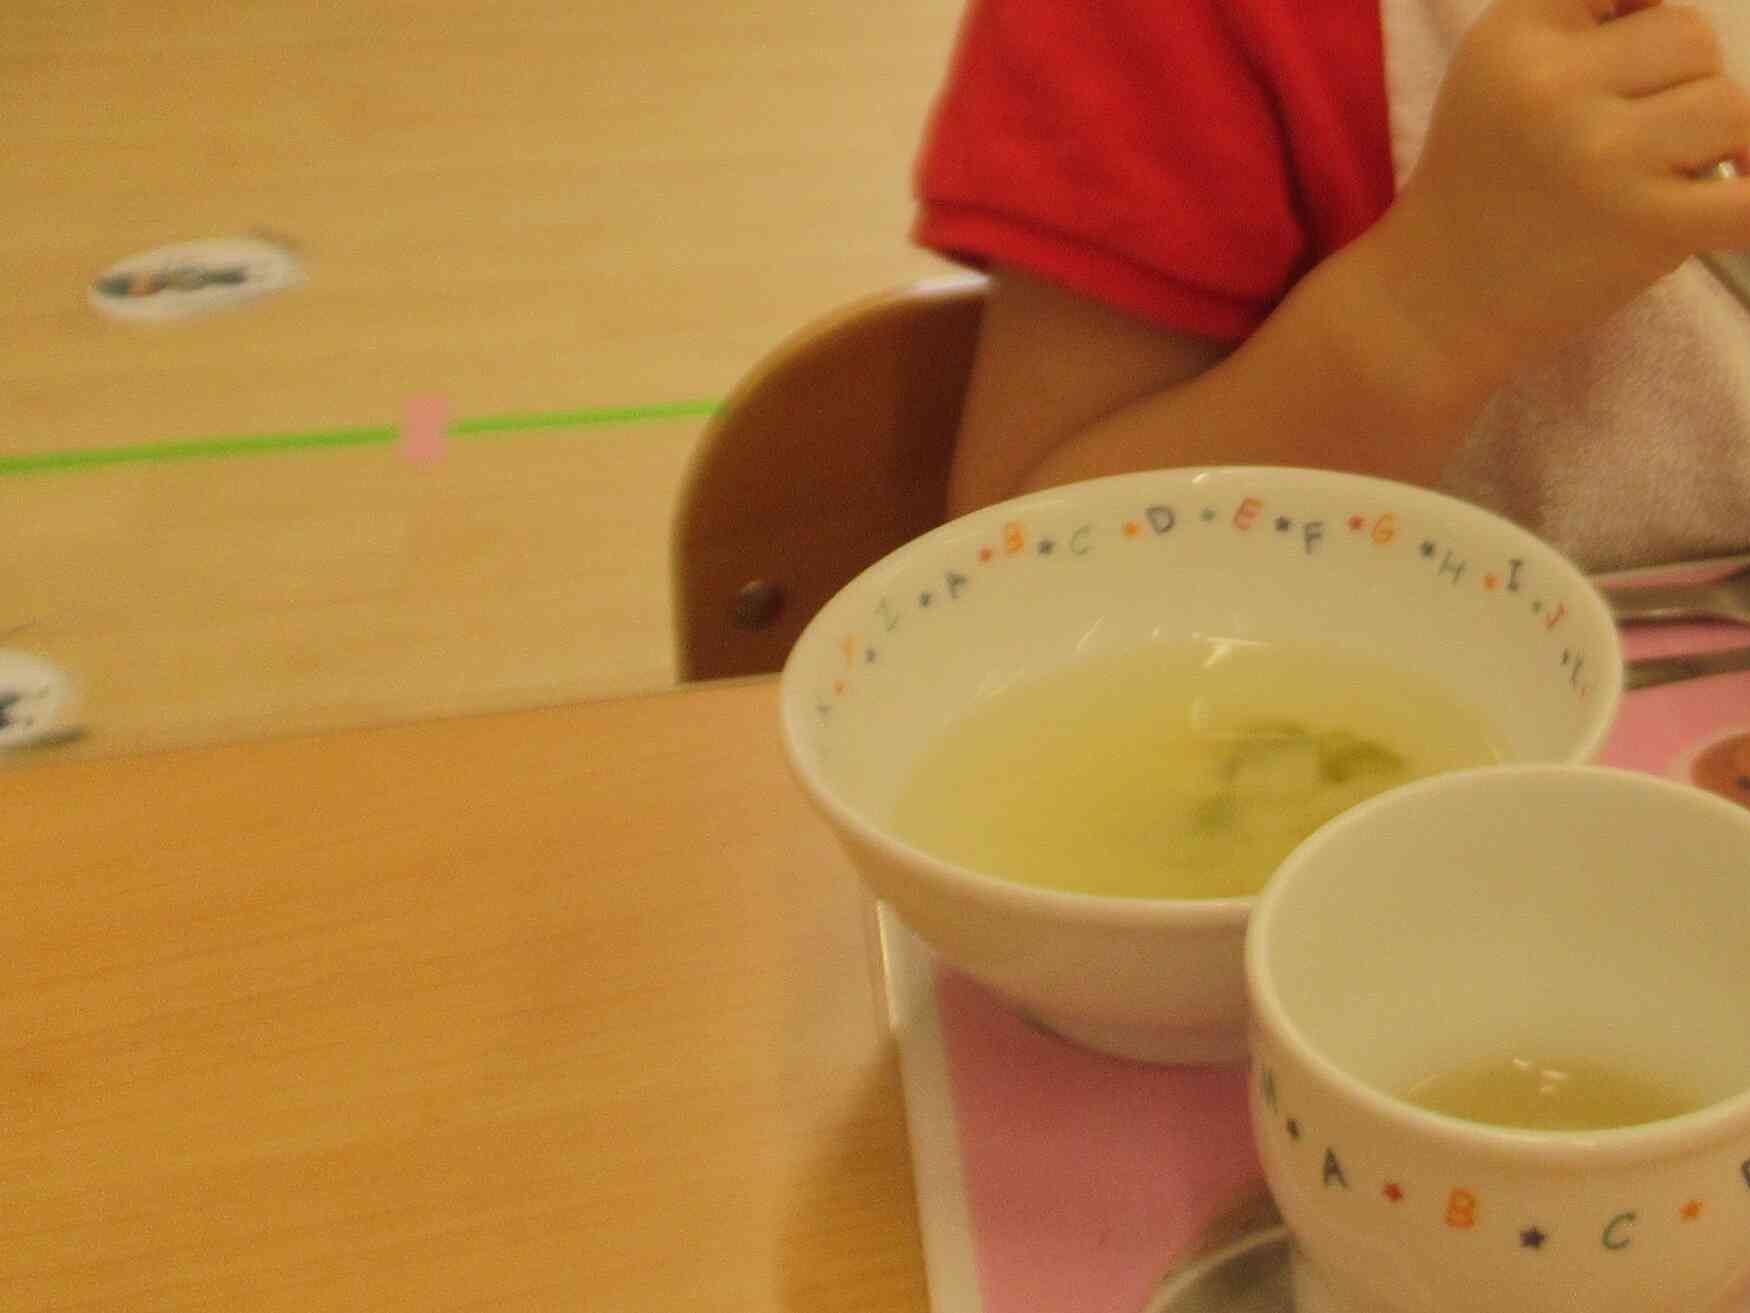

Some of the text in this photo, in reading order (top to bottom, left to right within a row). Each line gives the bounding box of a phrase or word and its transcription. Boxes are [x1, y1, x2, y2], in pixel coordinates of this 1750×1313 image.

[1003, 520, 1025, 554] B
[1069, 524, 1093, 557] C
[1145, 505, 1176, 535] D
[1233, 496, 1264, 531] E
[1303, 520, 1324, 556] F
[1370, 512, 1396, 545] G
[1507, 558, 1524, 591] I
[1322, 1146, 1348, 1190] A
[1446, 1188, 1481, 1231] B
[1602, 1211, 1637, 1251] C
